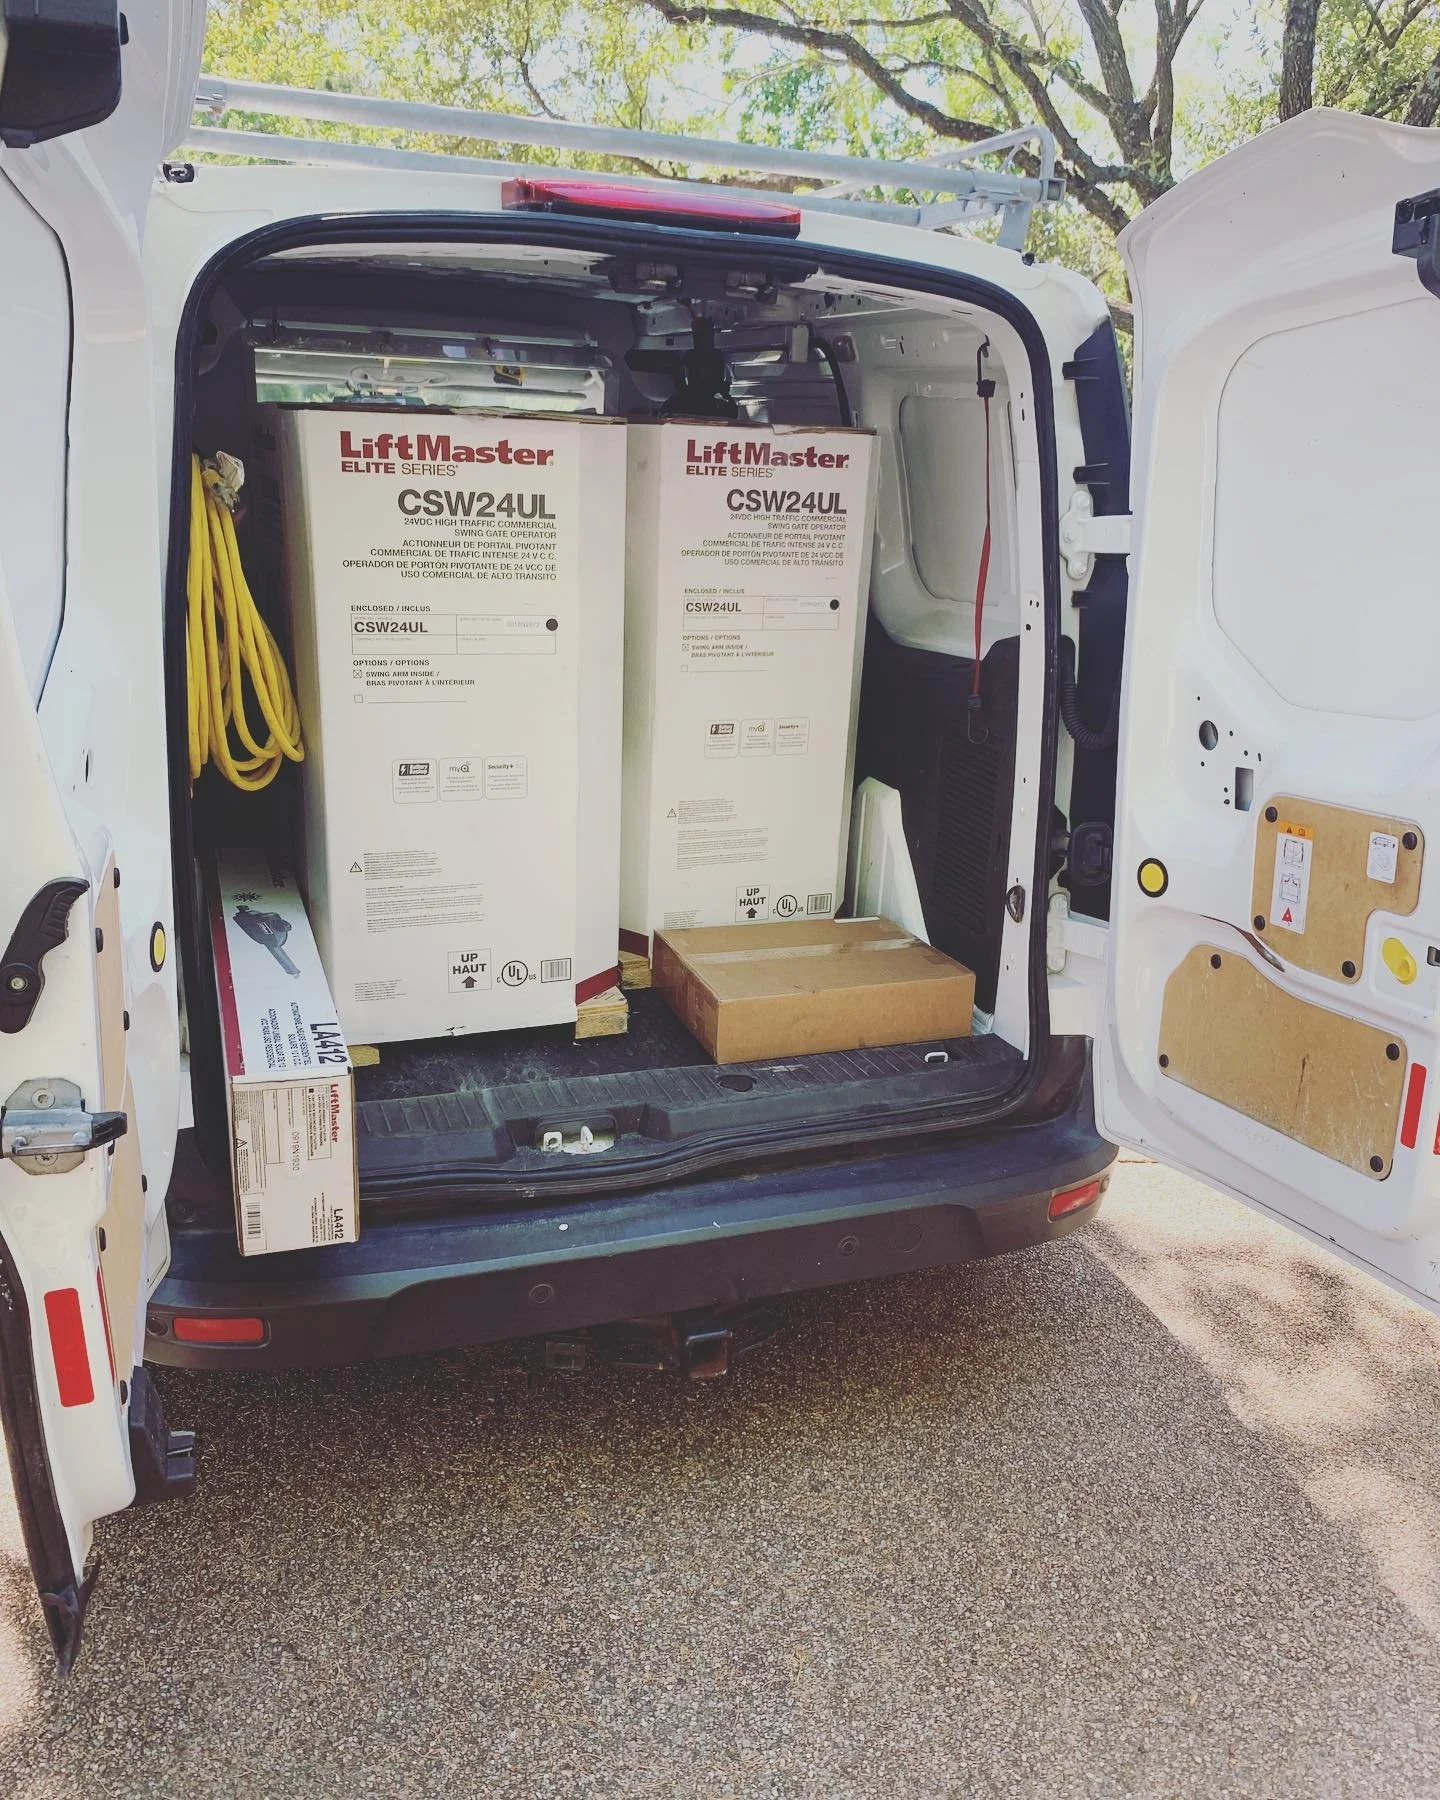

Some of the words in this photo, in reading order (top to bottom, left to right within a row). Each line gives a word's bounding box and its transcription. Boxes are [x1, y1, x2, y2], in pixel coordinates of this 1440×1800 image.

[340, 431, 554, 466] LiftMaster
[686, 440, 849, 468] LiftMaster
[341, 461, 395, 473] ELITE
[686, 465, 727, 476] ELITE
[398, 489, 555, 519] CSW24UL
[727, 489, 847, 514] CSW24UL
[404, 518, 432, 526] 24VDC
[435, 518, 456, 526] HIGH
[460, 519, 495, 527] TRAFFIC
[498, 521, 556, 529] COMMERCIAL
[801, 515, 846, 523] COMMERCIAL
[455, 529, 483, 537] SWING
[486, 530, 508, 538] GATE
[510, 530, 556, 539] OPERATOR
[403, 540, 461, 548] ACTIONNEUR
[478, 541, 511, 549] PORTAIL
[515, 542, 556, 550] PIVOTANT
[371, 548, 431, 557] COMMERCIAL
[450, 550, 480, 558] TRAFIC
[482, 551, 518, 559] INTENSE
[343, 560, 394, 568] OPERADOR
[450, 562, 497, 570] PIVOTANTE
[500, 563, 512, 571] DE
[514, 563, 523, 571] 24
[491, 572, 512, 580] ALTO
[686, 602, 741, 612] CSW24UL
[354, 621, 428, 633] CSW24UL
[746, 888, 760, 896] UP
[740, 897, 766, 906] HAUT
[782, 899, 792, 912] UL
[461, 953, 478, 962] UP
[453, 963, 486, 974] HAUT
[508, 966, 522, 980] UL
[310, 1023, 347, 1064] LA412
[330, 1084, 339, 1143] LiftMaster
[334, 1209, 343, 1239] LA412
